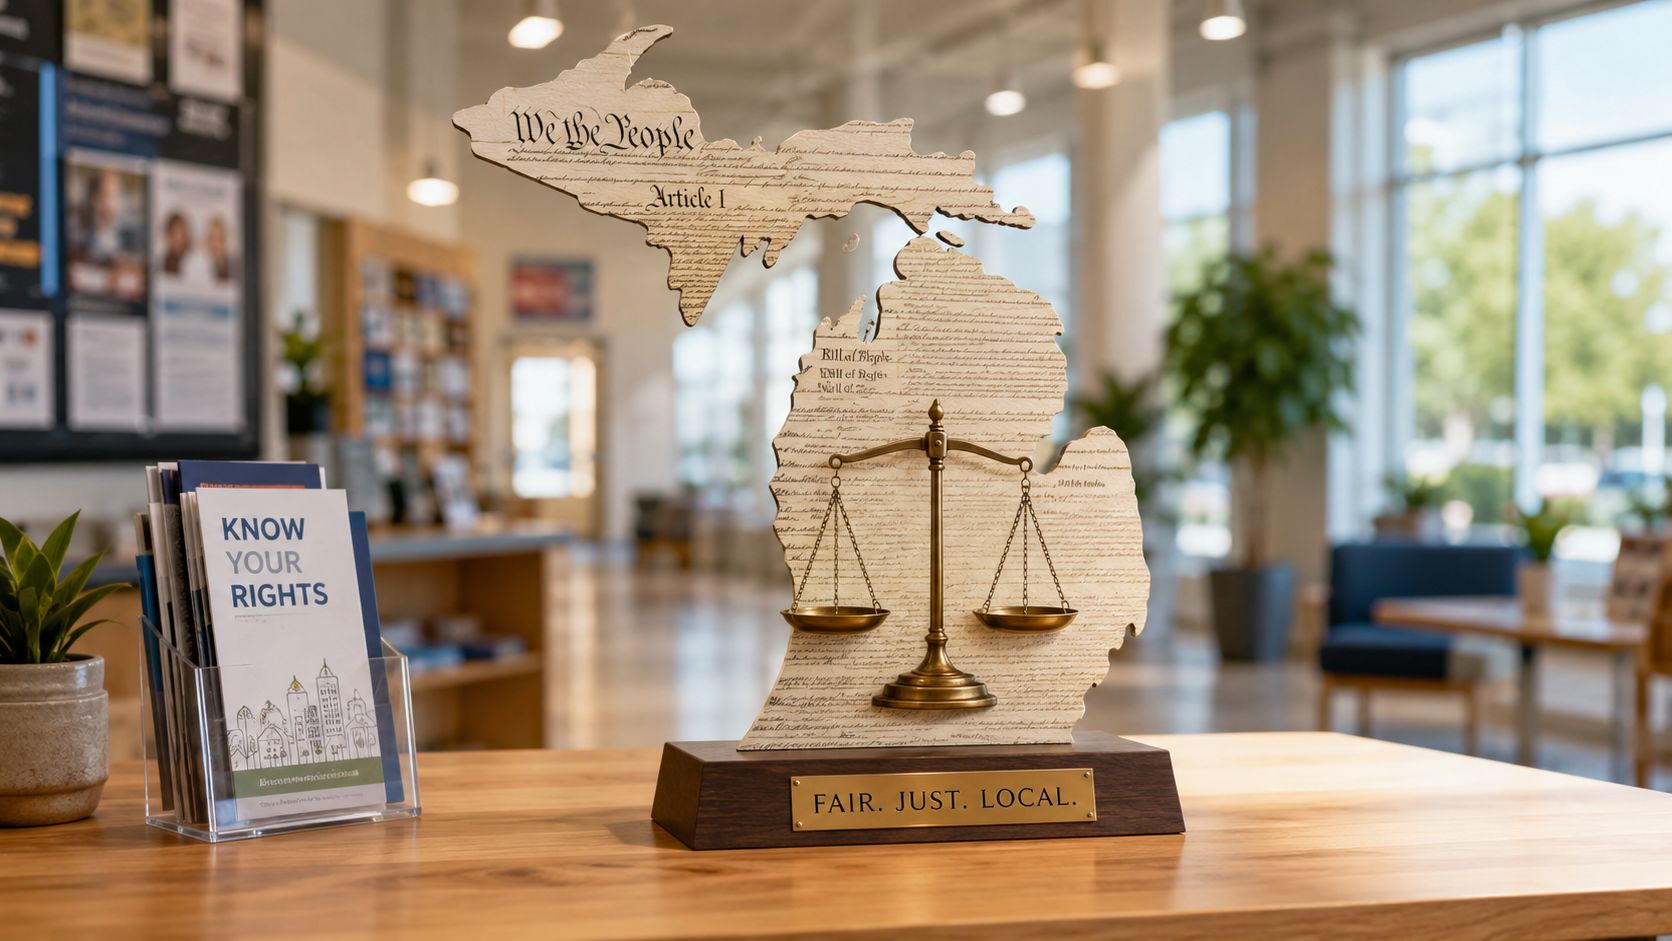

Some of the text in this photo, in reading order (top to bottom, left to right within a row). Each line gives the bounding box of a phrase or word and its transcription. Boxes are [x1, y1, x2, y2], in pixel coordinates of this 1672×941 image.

[510, 105, 695, 160] We the People
[645, 184, 712, 211] Article
[718, 188, 725, 209] I
[221, 517, 305, 541] KNOW
[225, 550, 303, 575] YOUR
[230, 582, 329, 608] RIGHTS
[813, 786, 1077, 814] FAIR. JUST. LOCAL.
